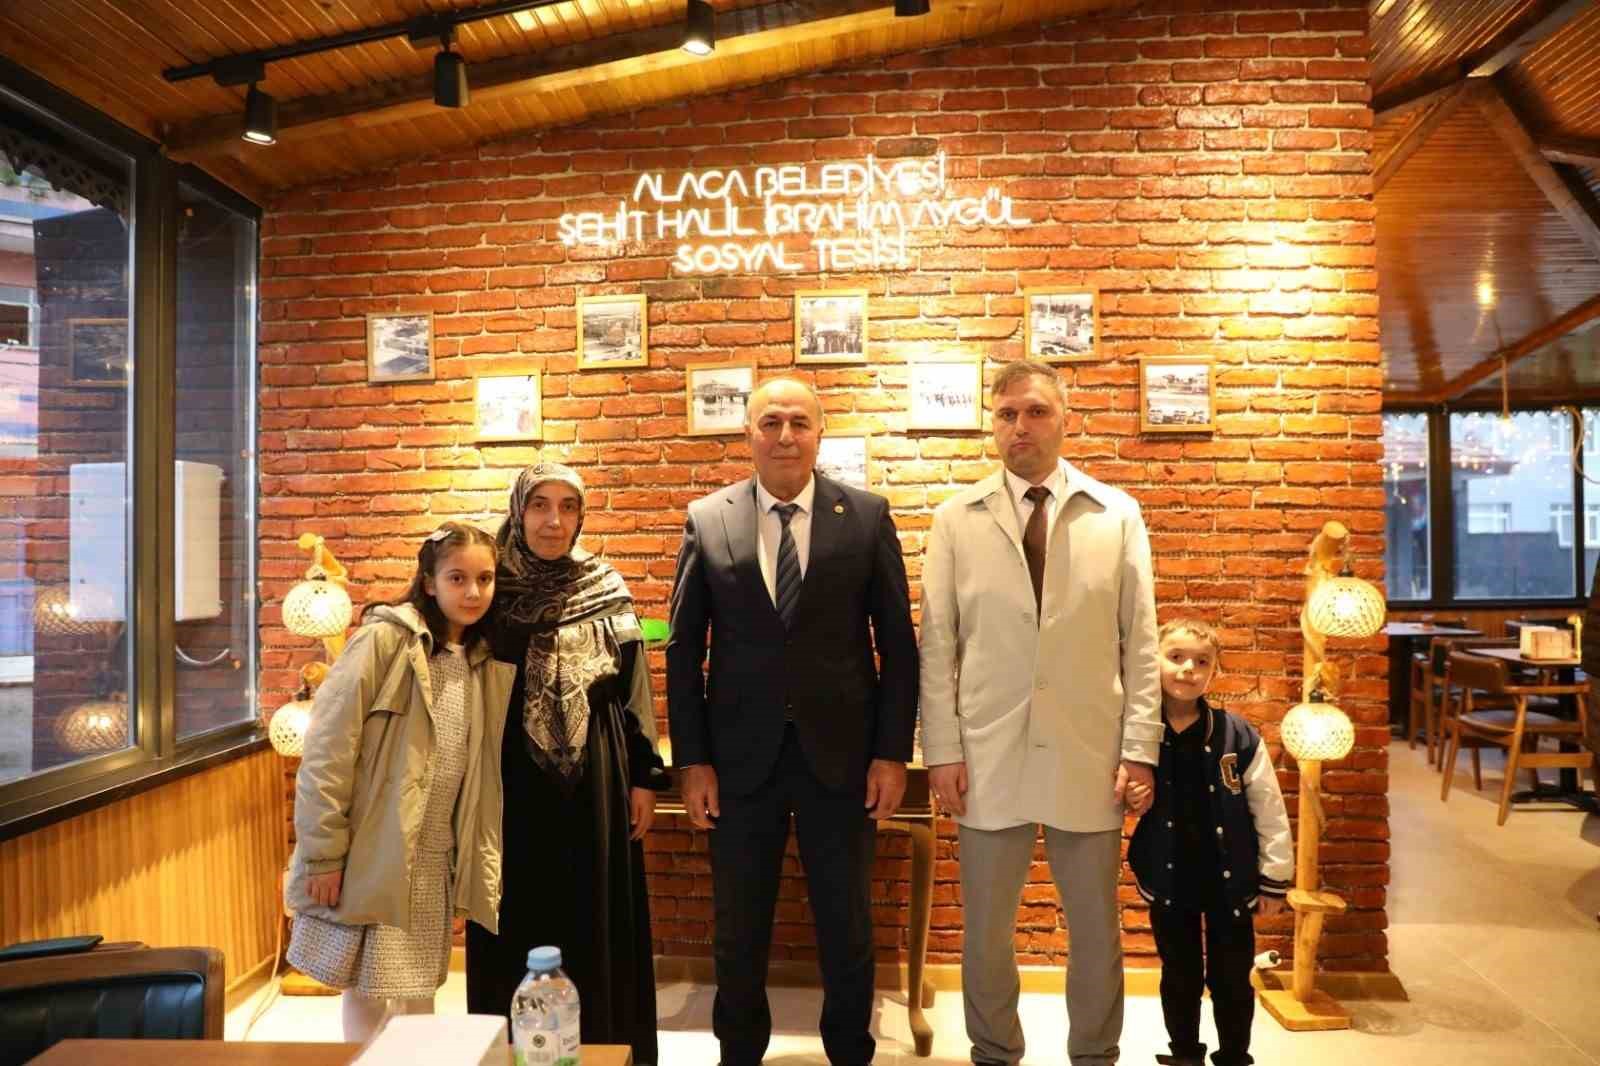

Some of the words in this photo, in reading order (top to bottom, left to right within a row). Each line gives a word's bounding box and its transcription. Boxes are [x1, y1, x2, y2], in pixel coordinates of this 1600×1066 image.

[633, 169, 748, 202] ALACA
[911, 187, 1032, 227] AYGÜL
[672, 241, 804, 272] SOSYAL
